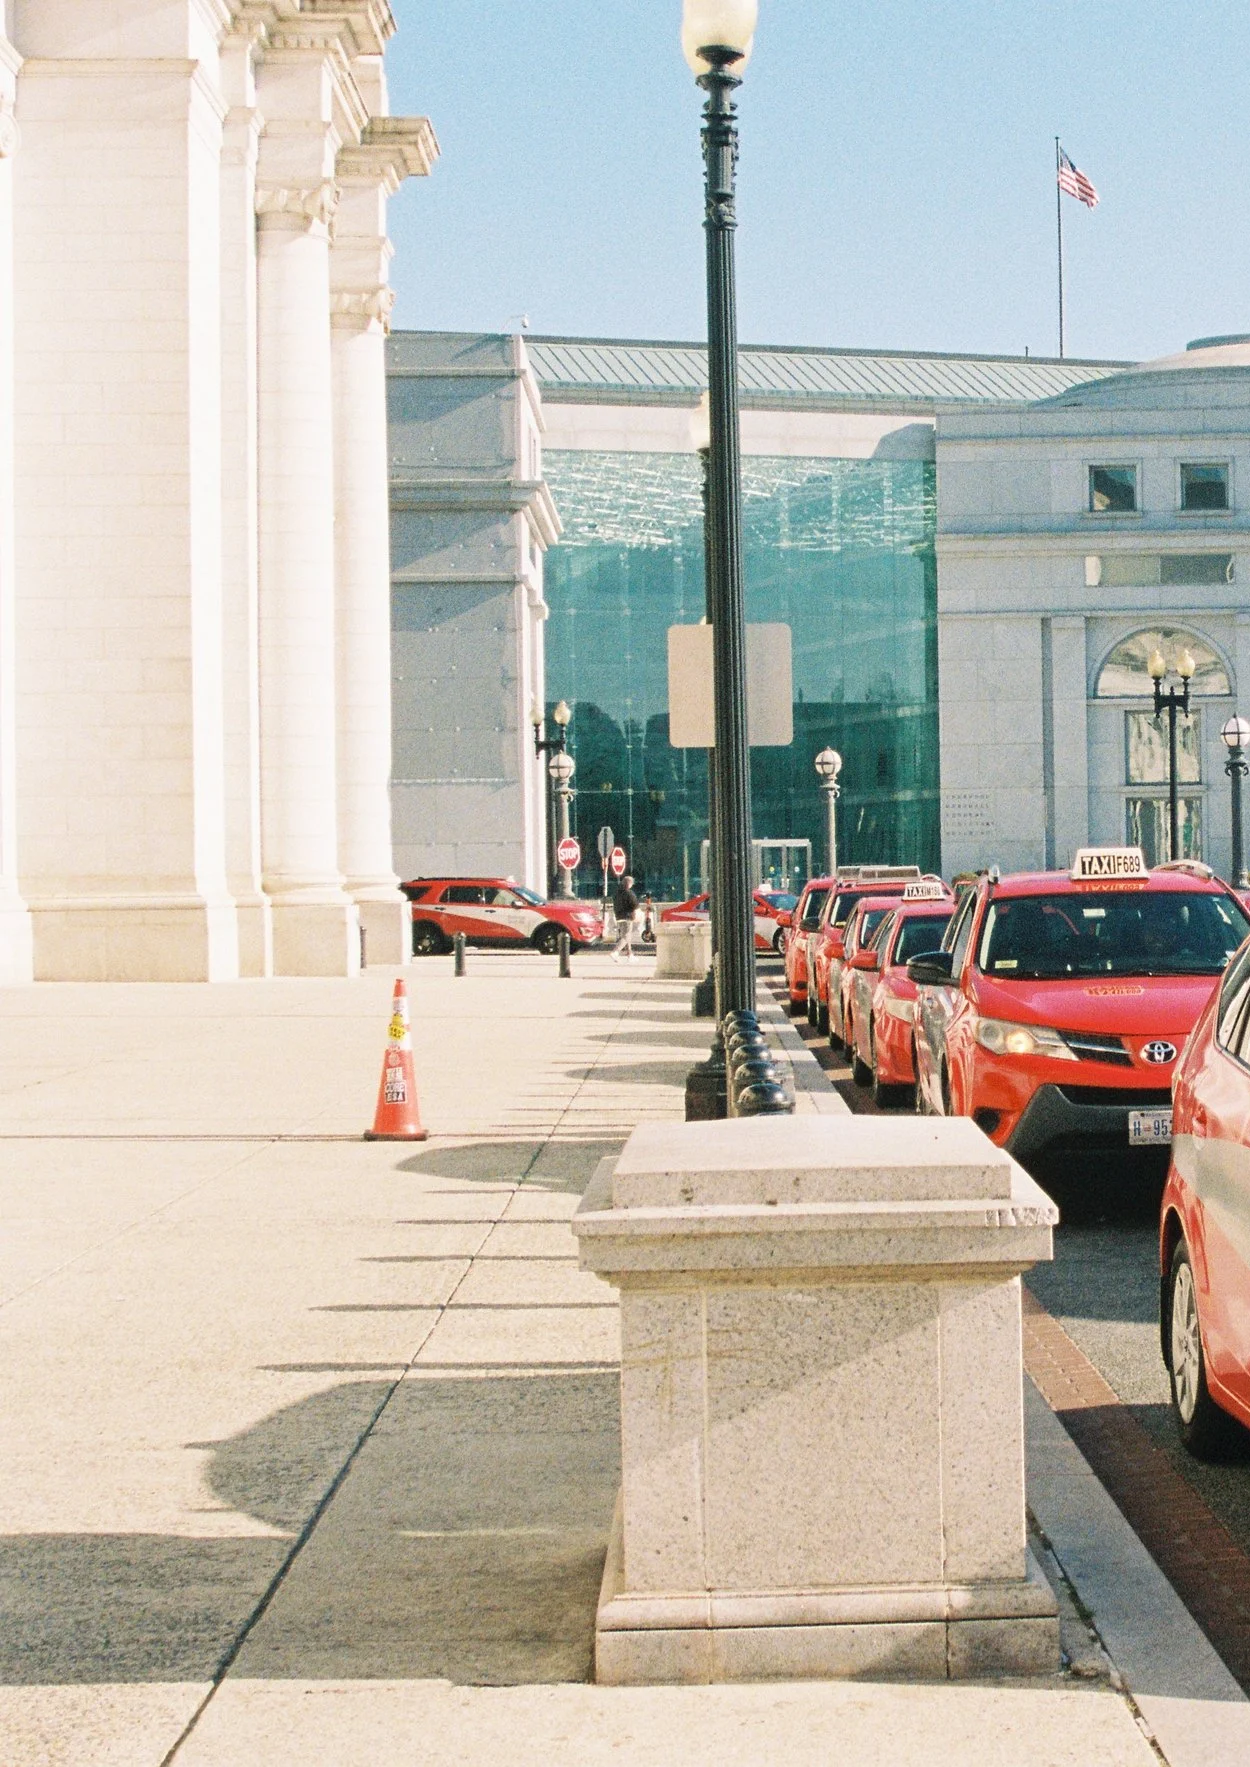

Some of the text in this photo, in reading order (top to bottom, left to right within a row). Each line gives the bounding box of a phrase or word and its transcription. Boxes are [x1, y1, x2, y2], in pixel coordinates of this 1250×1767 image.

[560, 848, 578, 860] STOP
[1081, 855, 1141, 875] TAXI F689
[907, 886, 926, 898] TAXI
[1133, 1120, 1141, 1136] H
